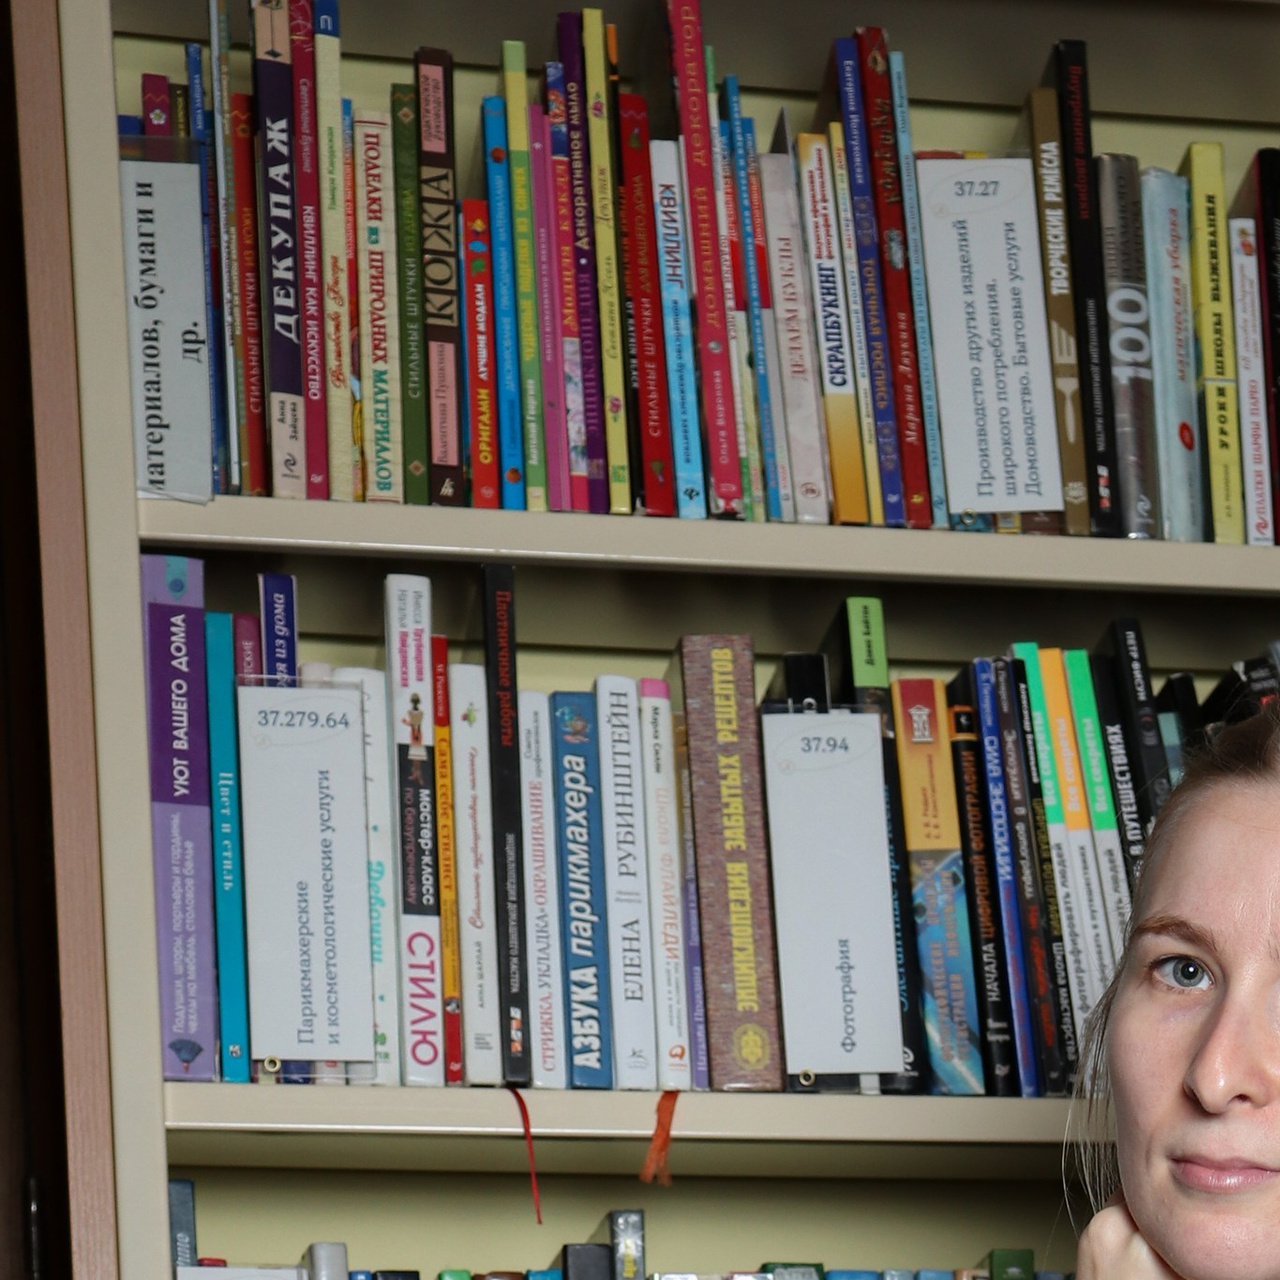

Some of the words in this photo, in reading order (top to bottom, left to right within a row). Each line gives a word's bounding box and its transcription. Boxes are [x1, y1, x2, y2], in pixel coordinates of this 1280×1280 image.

[134, 182, 154, 198] и
[954, 182, 999, 197] 37.27
[1038, 142, 1062, 202] РЕМЁСЛА
[133, 209, 158, 308] бумаги
[266, 117, 299, 343] ДЕКУПАЖ
[424, 168, 455, 320] КОЖА
[659, 183, 683, 288] КВИЛЛИНГ
[952, 219, 972, 295] изделий
[1001, 221, 1022, 282] услуги
[1046, 208, 1069, 294] ТВОРЧЕСКИЕ
[176, 321, 204, 362] др.
[368, 250, 389, 362] ПРИРОДНЫХ
[818, 263, 848, 386] СКРАПБУКИНГ
[963, 300, 984, 362] других
[983, 279, 1008, 402] потребления.
[1006, 286, 1029, 367] Бытовые
[1108, 284, 1151, 384] 100
[372, 370, 391, 490] МАТЕРИАЛОВ
[477, 388, 492, 464] ОРИГАМИ
[965, 366, 996, 496] Производство
[995, 406, 1018, 496] широкого
[1015, 372, 1042, 496] Домоводство.
[169, 614, 188, 672] ДОМА
[172, 679, 188, 750] ВАШЕГО
[258, 710, 350, 728] 37.279.64
[711, 648, 737, 742] РЕЦЕПТОВ
[174, 759, 190, 796] УЮТ
[606, 691, 637, 876] РУБИНШТЕЙН
[801, 736, 848, 753] 37.94
[1106, 724, 1142, 840] ПУТЕШЕСТВИЯХ
[316, 770, 332, 832] услуги
[528, 781, 547, 905] ОКРАШИВАНИЕ
[719, 756, 746, 850] ЗАБЫТЫХ
[962, 751, 984, 851] ФОТОГРАФИИ
[560, 755, 594, 957] парикмахера
[971, 855, 994, 938] ЦИФРОВОЙ
[293, 881, 314, 1044] Парикмахерские
[317, 837, 342, 1029] косметологические
[622, 920, 644, 1002] ЕЛЕНА
[726, 862, 759, 1011] ЭНЦИКЛОПЕДИЯ
[980, 943, 1000, 1001] НАЧАЛА
[327, 1034, 339, 1044] и
[407, 932, 438, 1065] СТИЛЮ
[569, 967, 601, 1068] АЗБУКА
[835, 939, 857, 1052] Фотография
